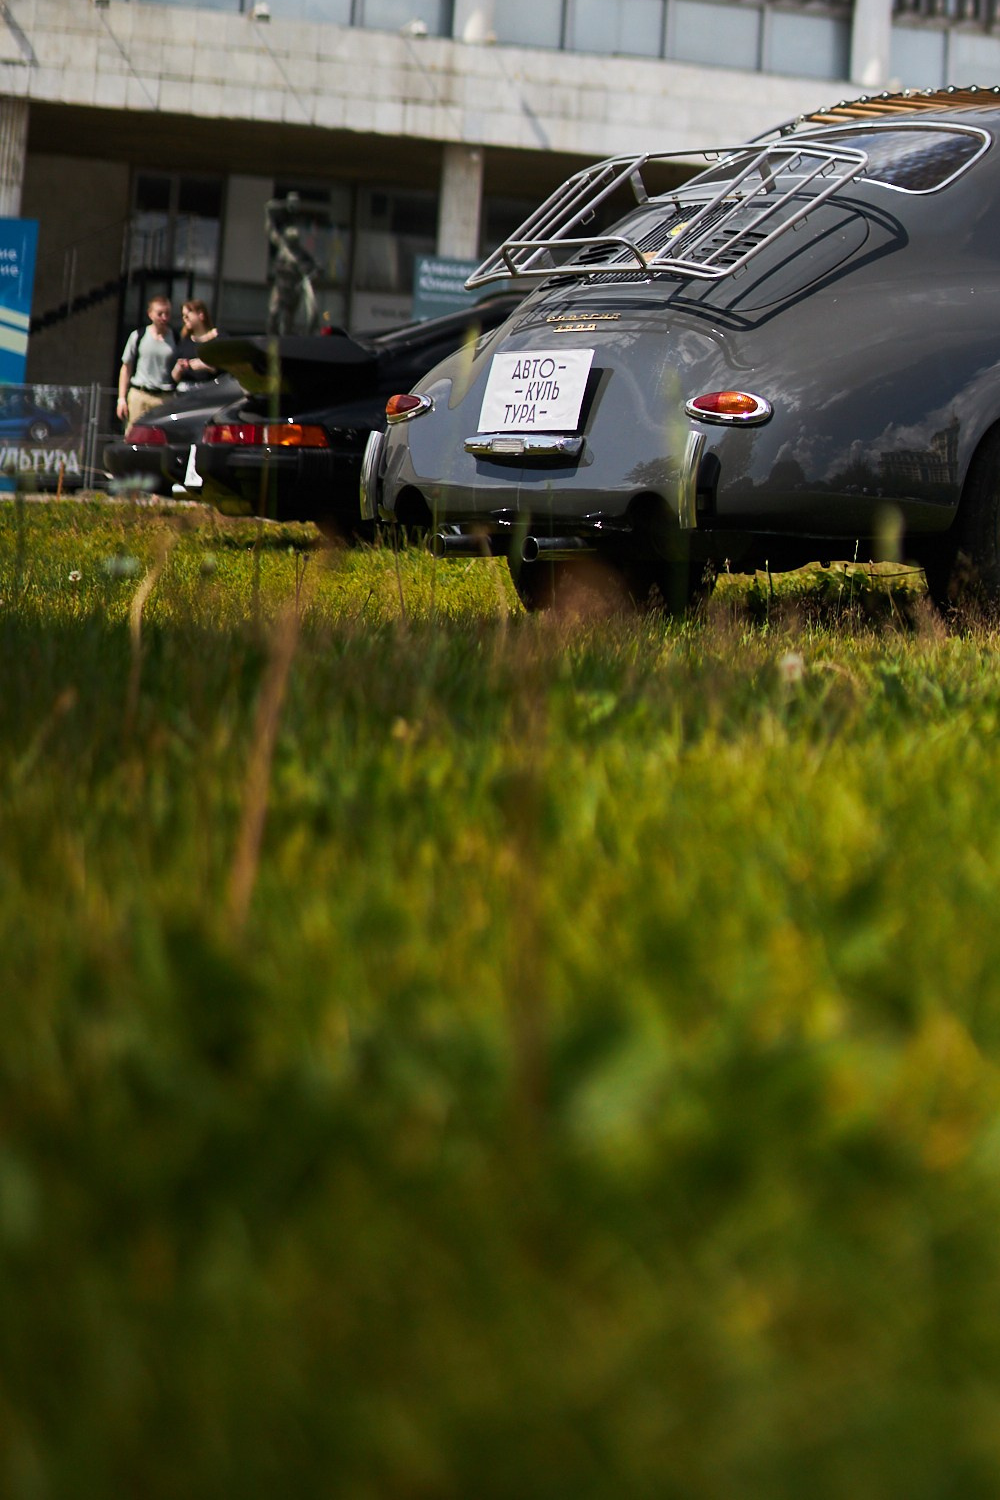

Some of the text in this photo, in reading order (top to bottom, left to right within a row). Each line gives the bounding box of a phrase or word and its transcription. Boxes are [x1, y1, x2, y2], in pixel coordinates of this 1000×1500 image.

[511, 358, 567, 380] АВТО-
[514, 381, 560, 401] -КУЛЬ
[503, 404, 548, 424] ТУРА-
